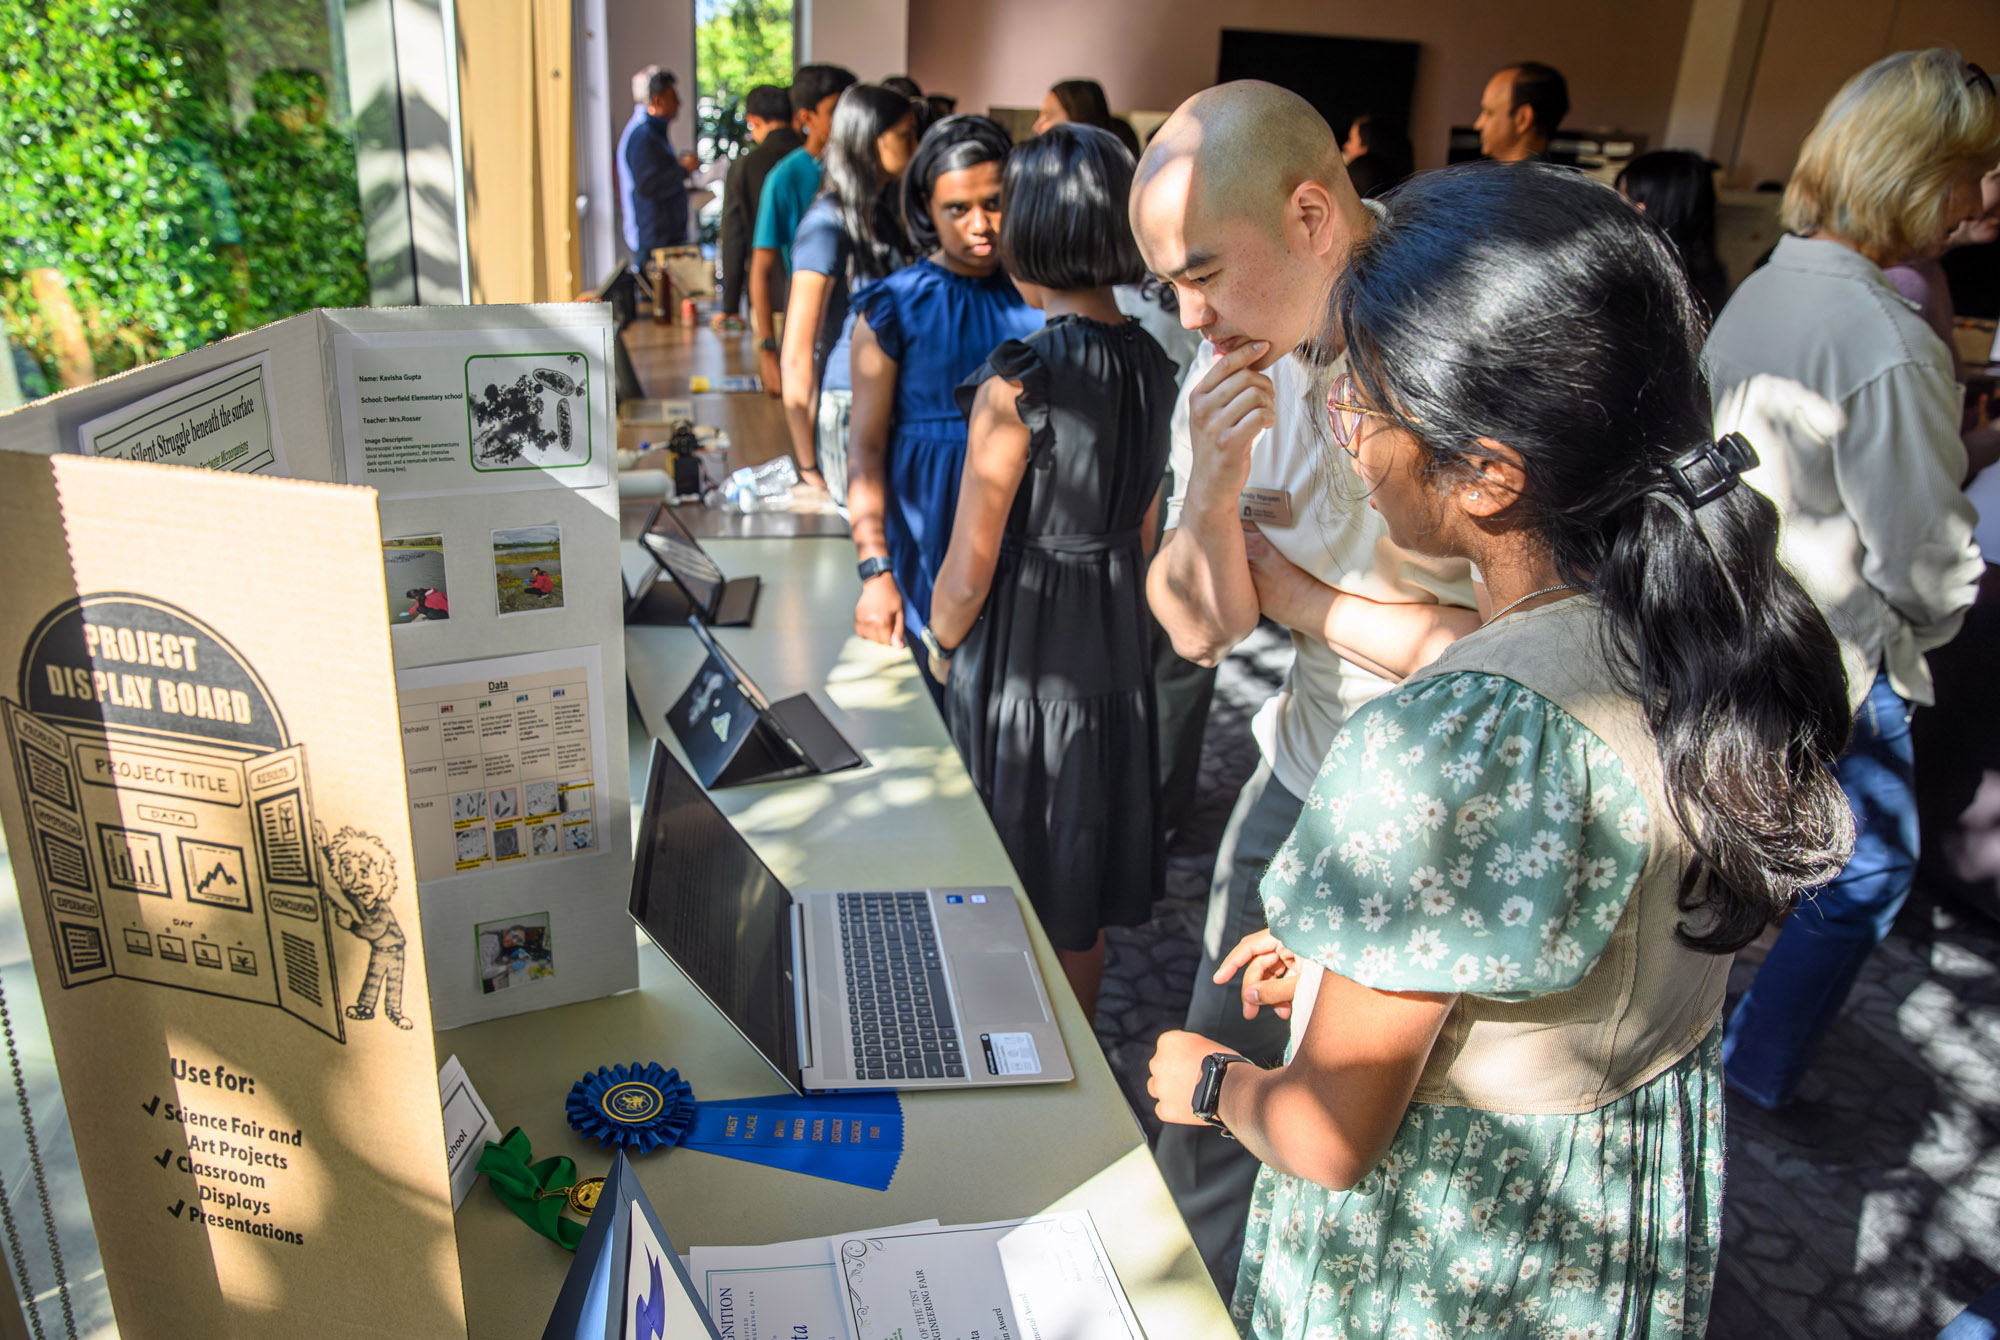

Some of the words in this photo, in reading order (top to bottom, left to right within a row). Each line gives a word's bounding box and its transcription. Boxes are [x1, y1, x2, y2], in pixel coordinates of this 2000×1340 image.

[361, 396, 382, 404] School:
[131, 440, 157, 462] Silent
[157, 422, 191, 458] Struggle
[191, 408, 220, 441] beneath
[220, 404, 231, 428] the
[232, 396, 254, 422] surface
[82, 623, 197, 672] PROJECT
[46, 664, 152, 710] DISPLAY
[158, 679, 251, 725] BOARD
[488, 680, 508, 692] Data
[404, 725, 430, 734] Behavior
[95, 758, 174, 784] PROJECT
[181, 772, 230, 793] TITLE
[409, 765, 438, 776] Summary
[414, 800, 434, 809] Picture
[151, 811, 188, 824] DATA
[272, 897, 316, 916] CONCLUSION
[173, 918, 194, 928] DAY
[171, 1058, 211, 1086] Use
[215, 1066, 255, 1094] for:
[164, 1103, 228, 1131] Science
[231, 1117, 264, 1139] Fair
[269, 1130, 302, 1147] and
[726, 1116, 738, 1137] FIRST
[744, 1115, 758, 1139] PLACE
[793, 1118, 805, 1140] UNIFIED
[812, 1118, 824, 1142] SCHOOL
[831, 1118, 842, 1143] DISTRICT
[850, 1120, 862, 1143] SCIENCE
[188, 1135, 216, 1154] Art
[219, 1141, 288, 1170] Projects
[176, 1156, 265, 1189] Classroom
[200, 1185, 271, 1216] Displays
[189, 1206, 304, 1245] Presentations
[916, 1269, 928, 1289] FAIR
[914, 1307, 926, 1327] THE
[992, 1307, 1008, 1331] Award
[920, 1327, 929, 1340] OF
